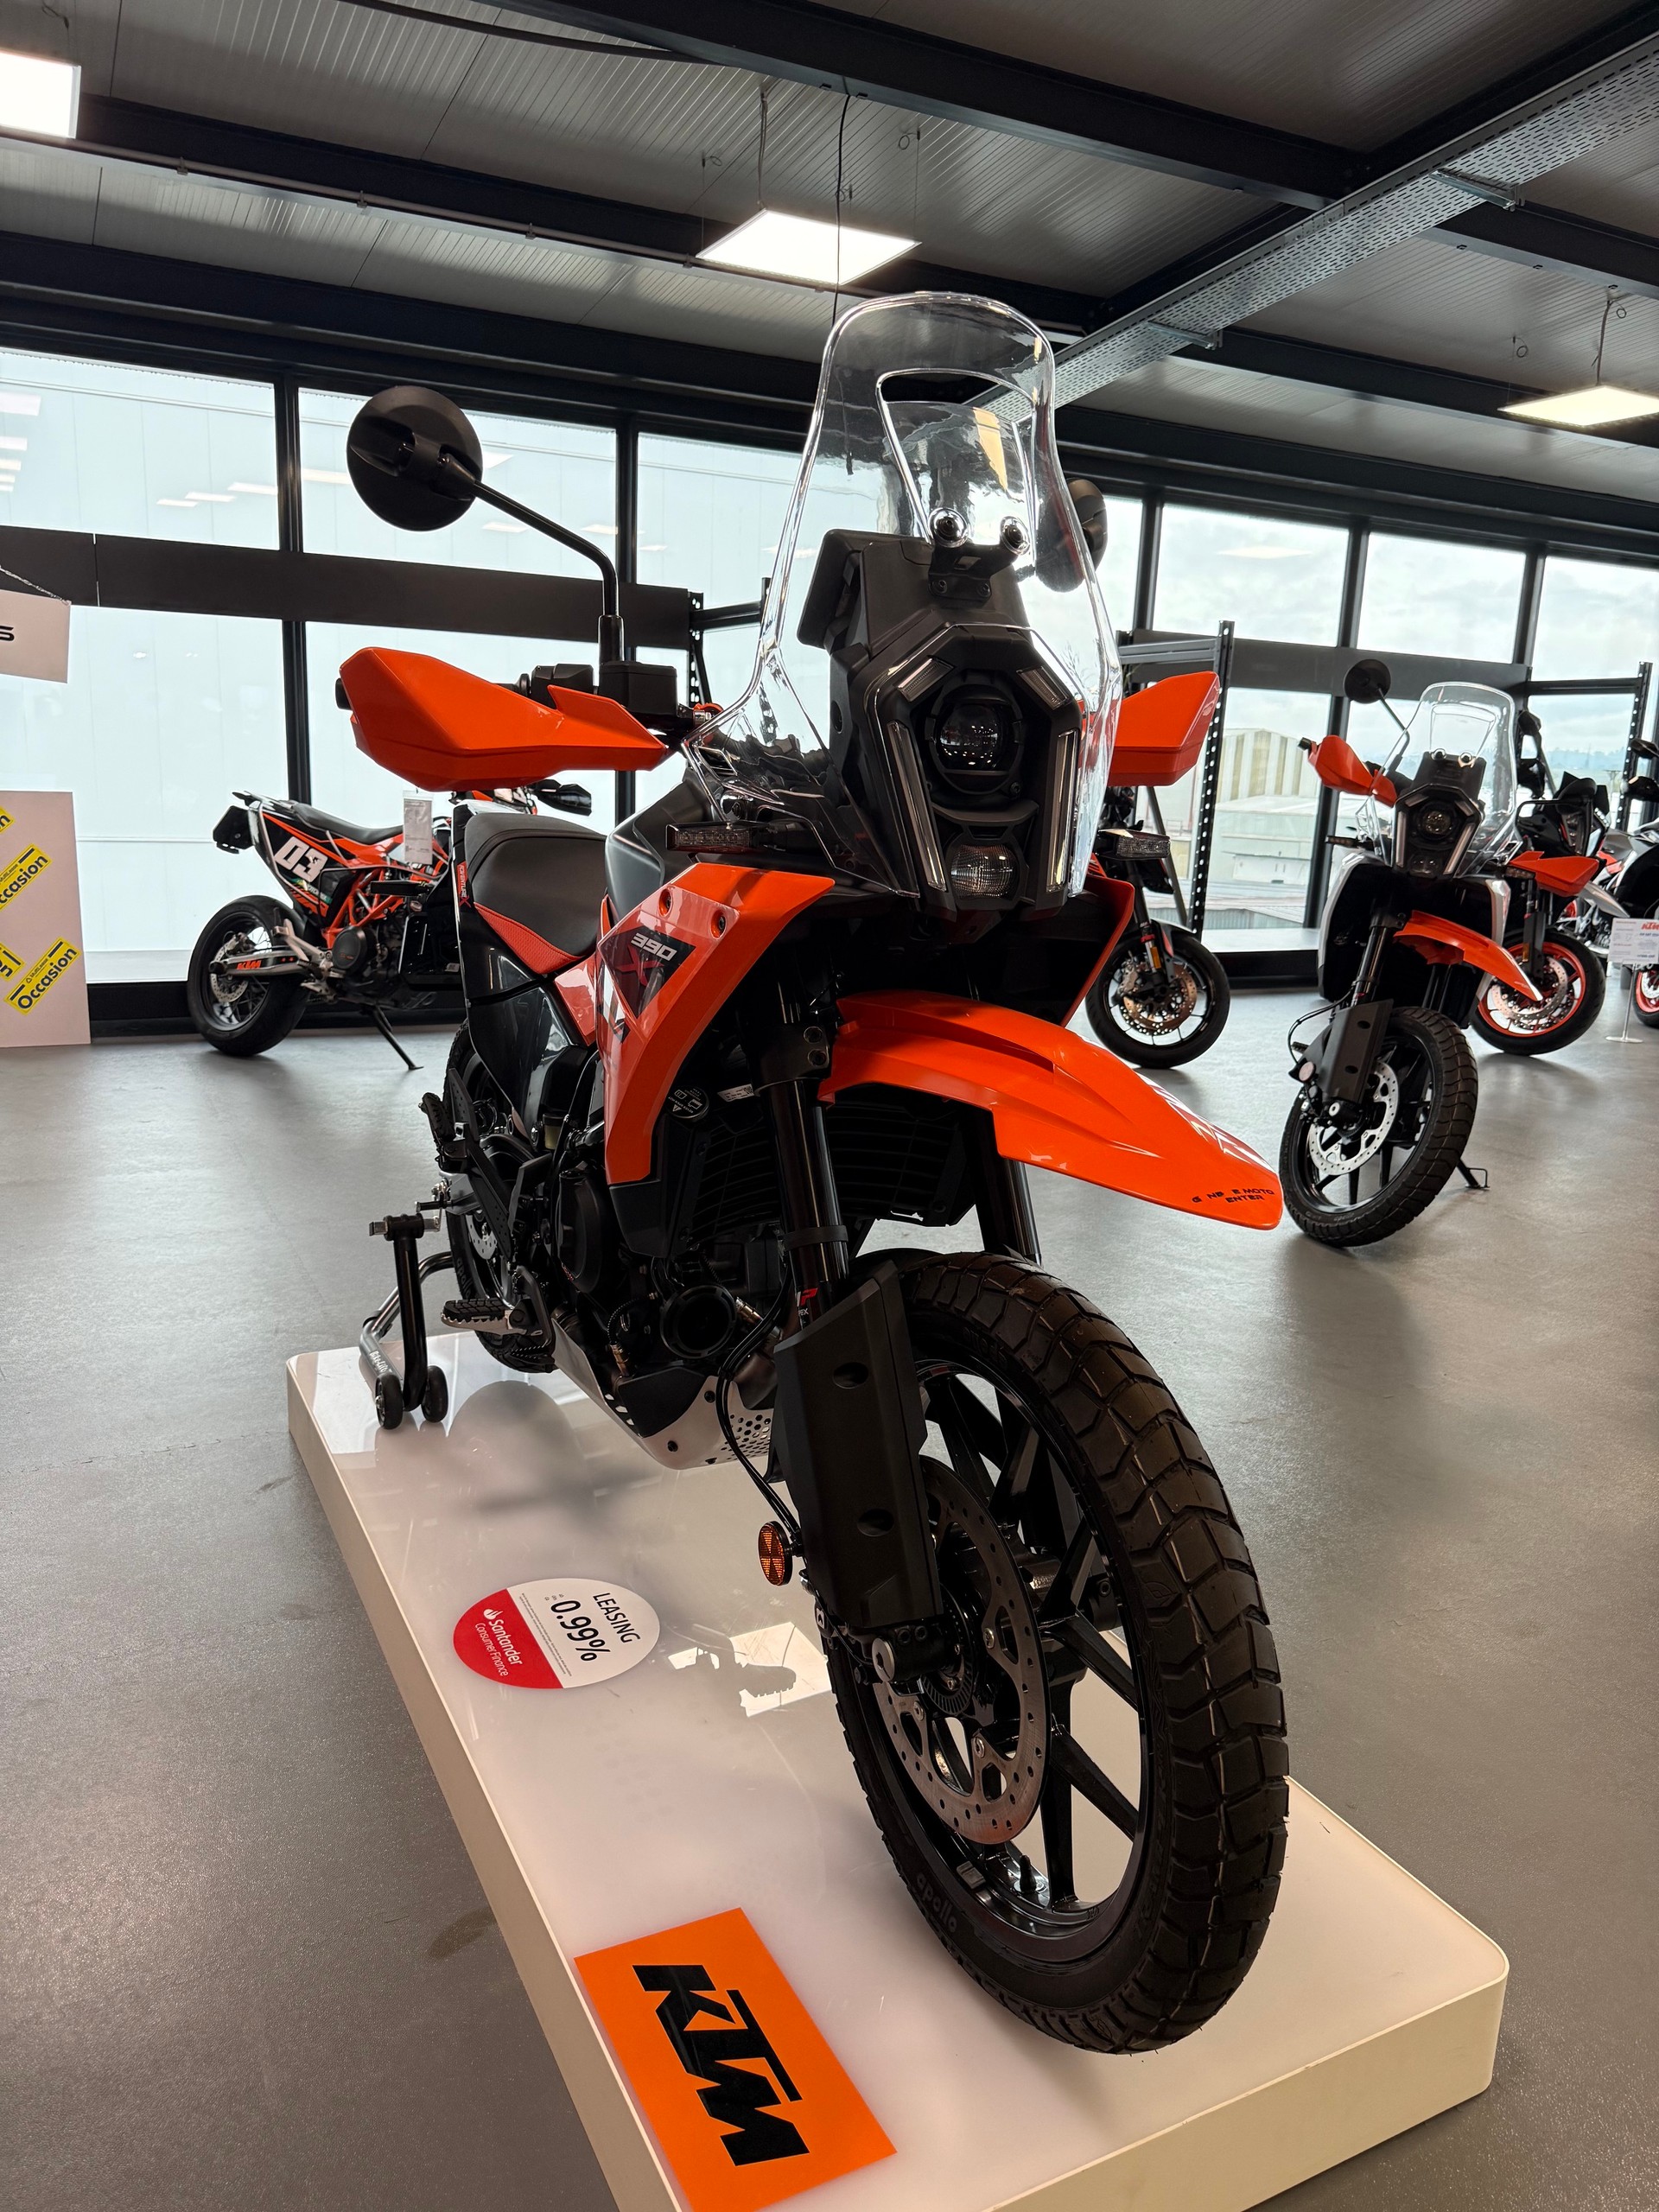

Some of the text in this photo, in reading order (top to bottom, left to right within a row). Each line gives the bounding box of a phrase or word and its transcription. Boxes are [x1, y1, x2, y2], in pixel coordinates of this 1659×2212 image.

[274, 836, 328, 882] 03
[237, 960, 263, 970] KTM
[630, 932, 677, 961] 390
[17, 949, 77, 1009] Occasion
[488, 1619, 523, 1665] Santander
[550, 1600, 611, 1661] 0.99%
[593, 1592, 641, 1643] LEASING
[474, 1623, 509, 1676] Consumer Finance
[917, 1872, 957, 1933] apollo
[632, 1965, 810, 2166] KTM
